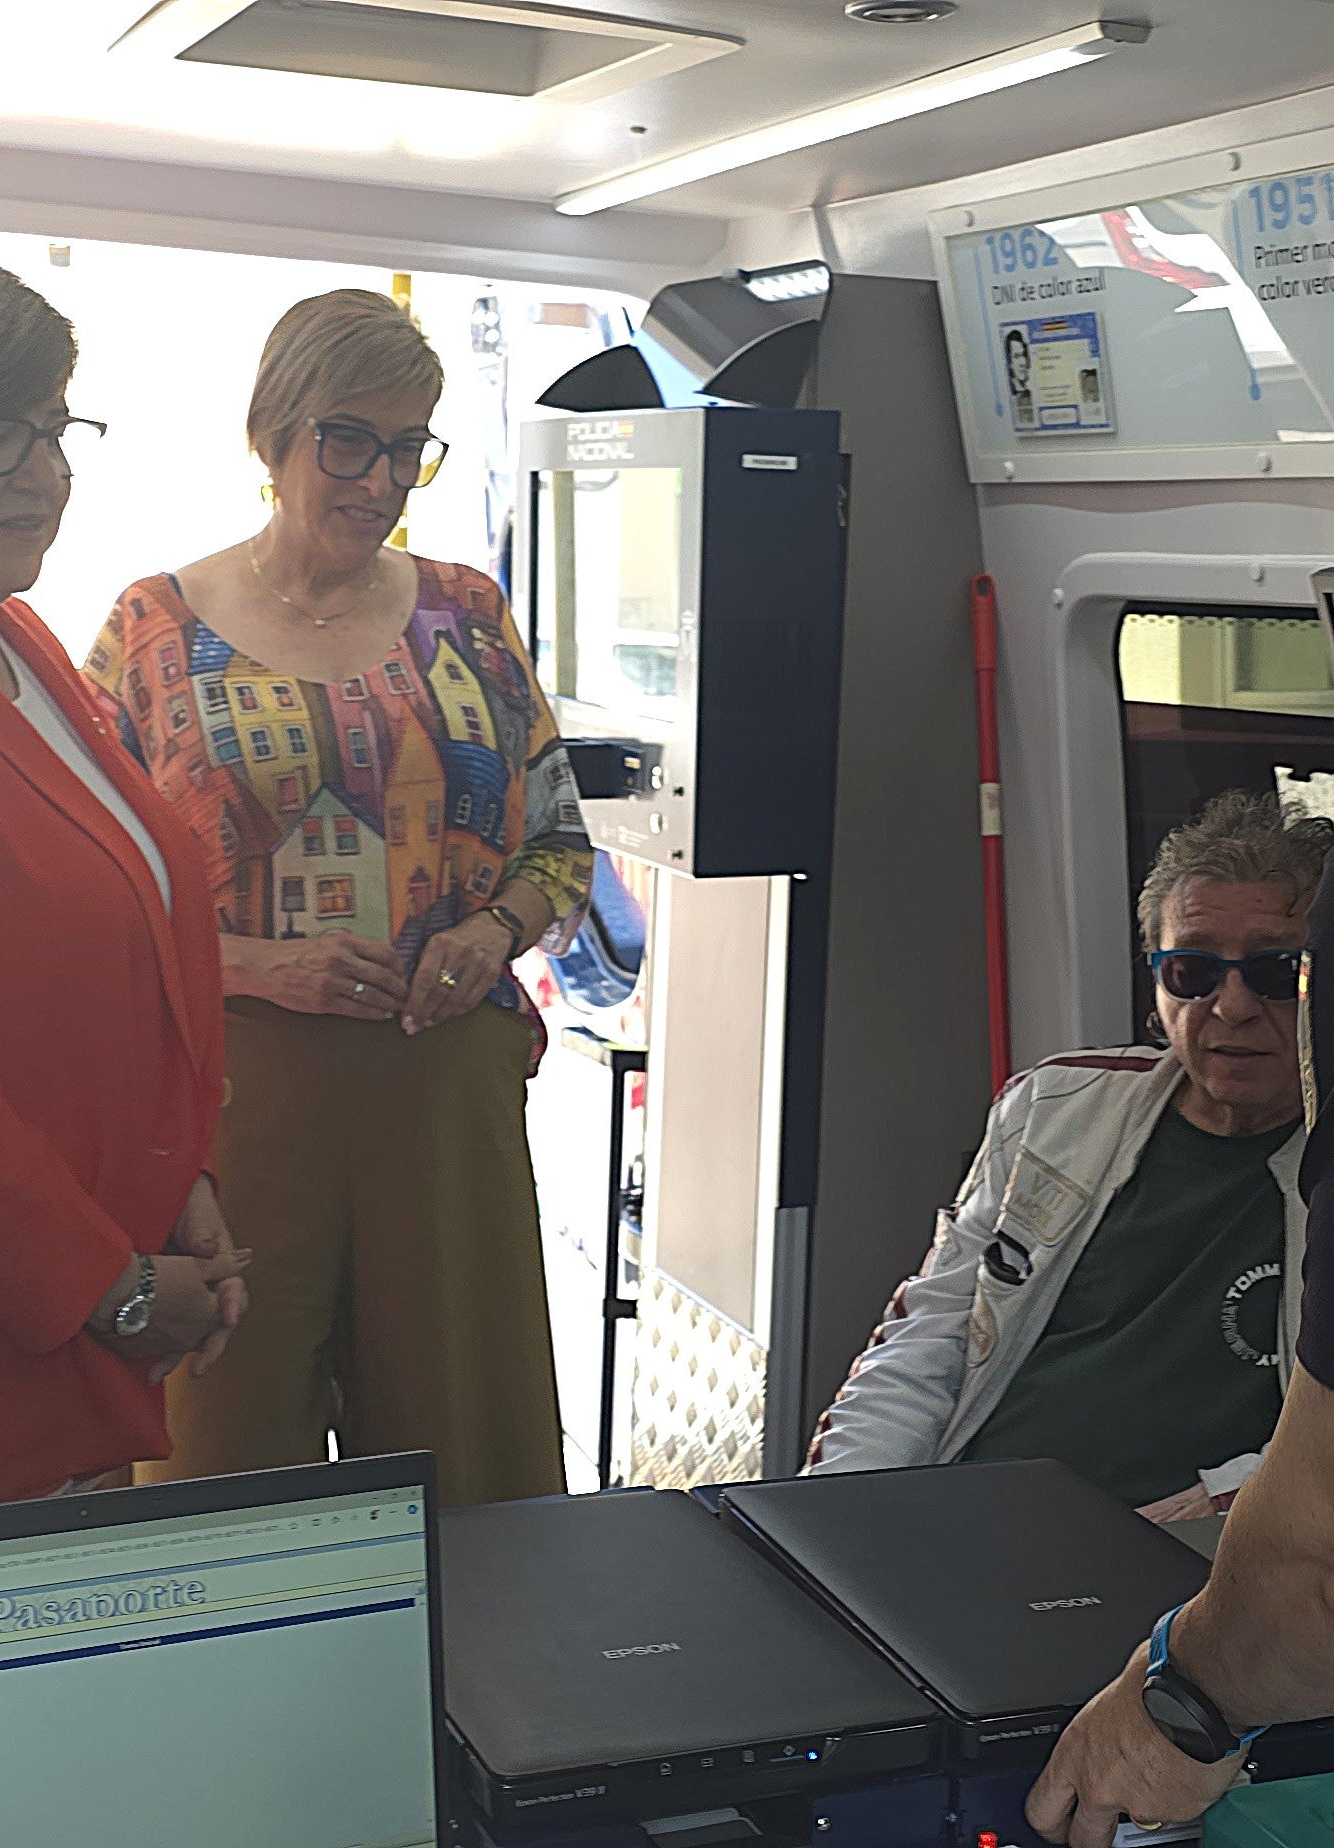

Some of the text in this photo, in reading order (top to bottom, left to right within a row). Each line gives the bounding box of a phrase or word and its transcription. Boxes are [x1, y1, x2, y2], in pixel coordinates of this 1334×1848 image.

[984, 226, 1060, 275] 1962
[1253, 243, 1309, 269] Primer
[1018, 280, 1036, 302] de
[1038, 275, 1072, 300] color
[1257, 275, 1300, 302] color
[1029, 1596, 1103, 1611] EPSON
[601, 1642, 682, 1660] EPSON
